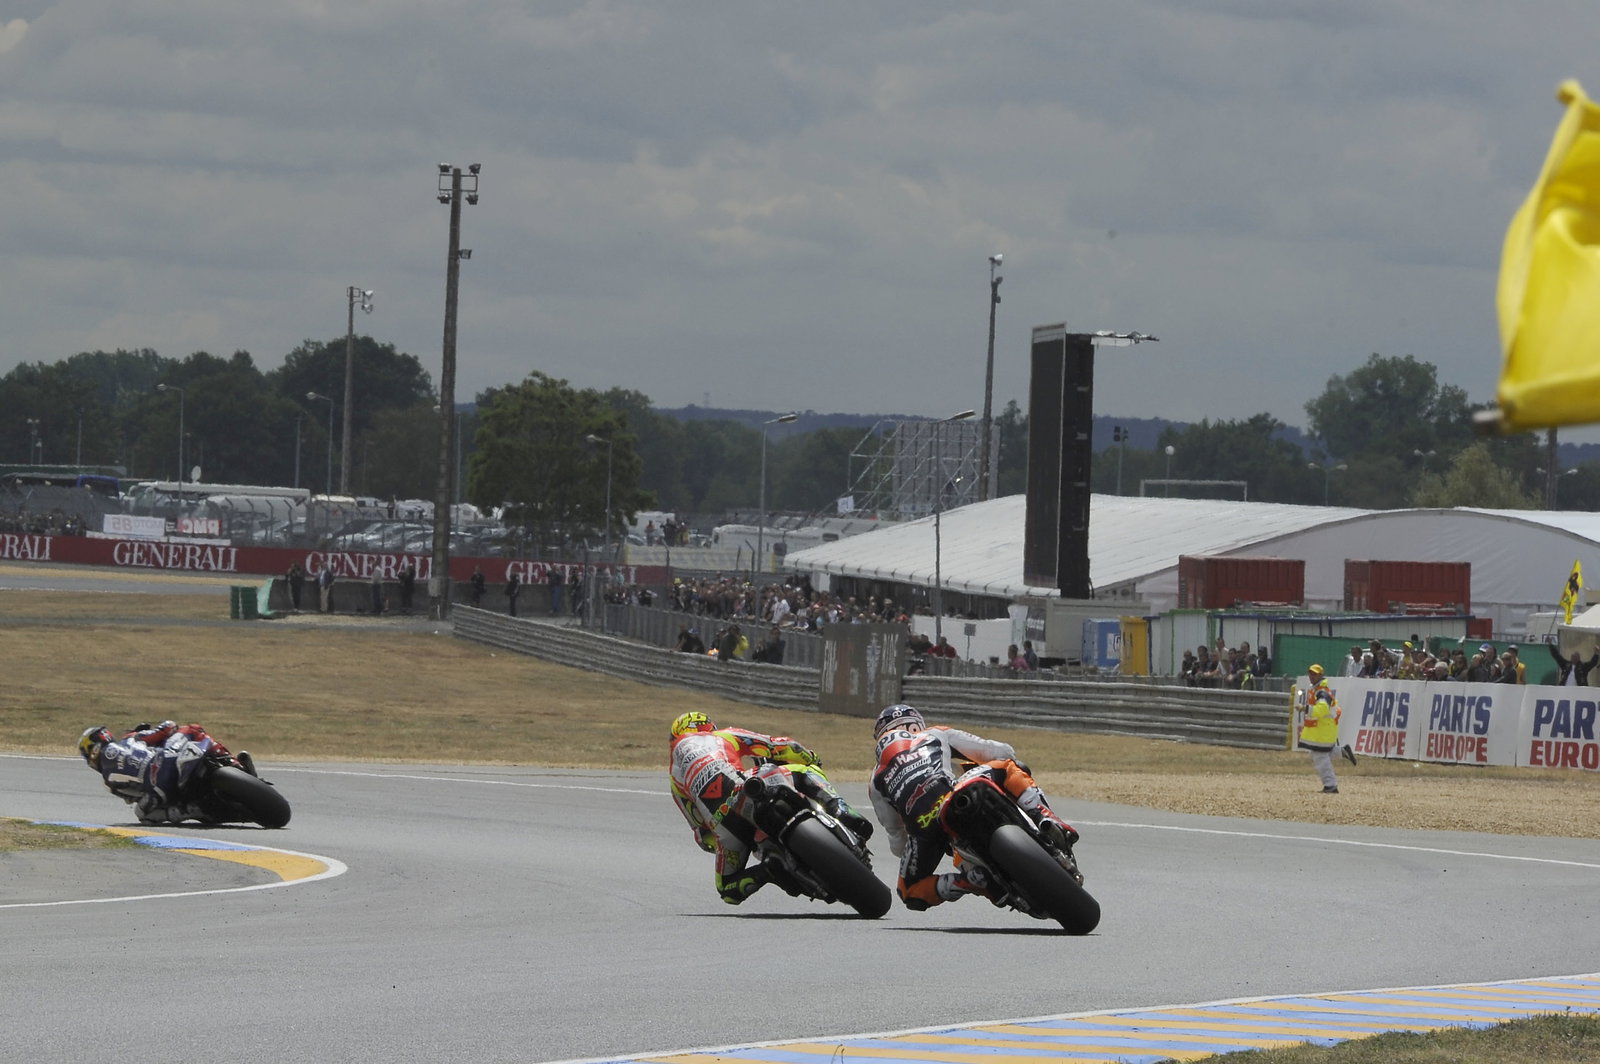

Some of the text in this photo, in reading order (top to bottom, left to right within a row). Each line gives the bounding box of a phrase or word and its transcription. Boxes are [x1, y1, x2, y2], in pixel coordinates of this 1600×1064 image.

[0, 534, 53, 560] RALI
[113, 541, 239, 572] GENERALI
[1429, 694, 1493, 735] PARTS
[1532, 699, 1600, 740] PAR
[876, 731, 917, 757] EPSO
[1426, 733, 1488, 762] EUROPE
[1530, 740, 1599, 769] EURO
